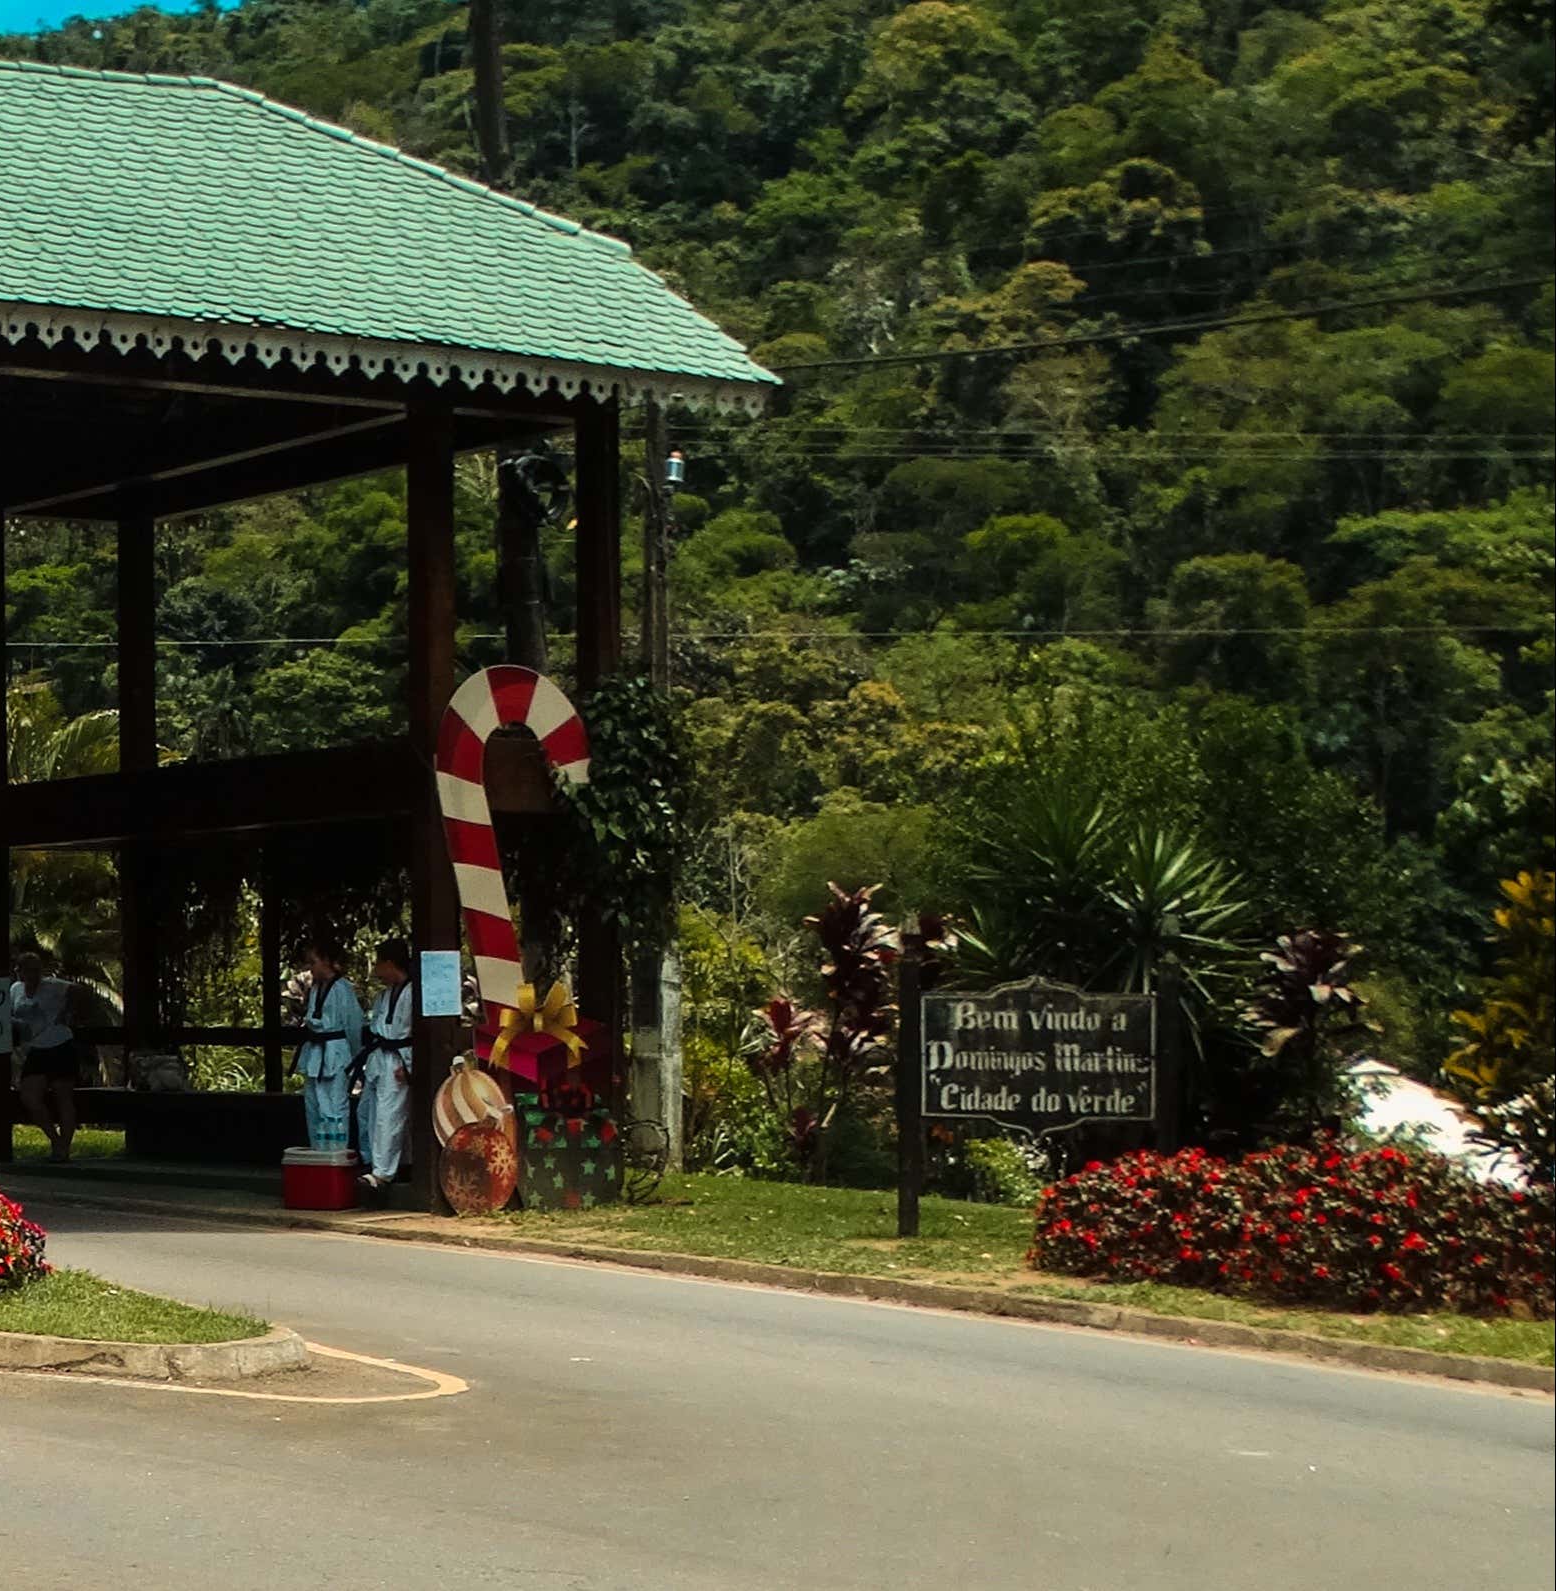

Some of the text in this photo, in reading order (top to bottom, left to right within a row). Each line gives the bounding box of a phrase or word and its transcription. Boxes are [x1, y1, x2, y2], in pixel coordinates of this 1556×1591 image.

[950, 1001, 1019, 1031] Bem
[1111, 1011, 1127, 1032] a
[926, 1041, 1149, 1077] Domingos Martins
[1031, 1086, 1062, 1113] do
